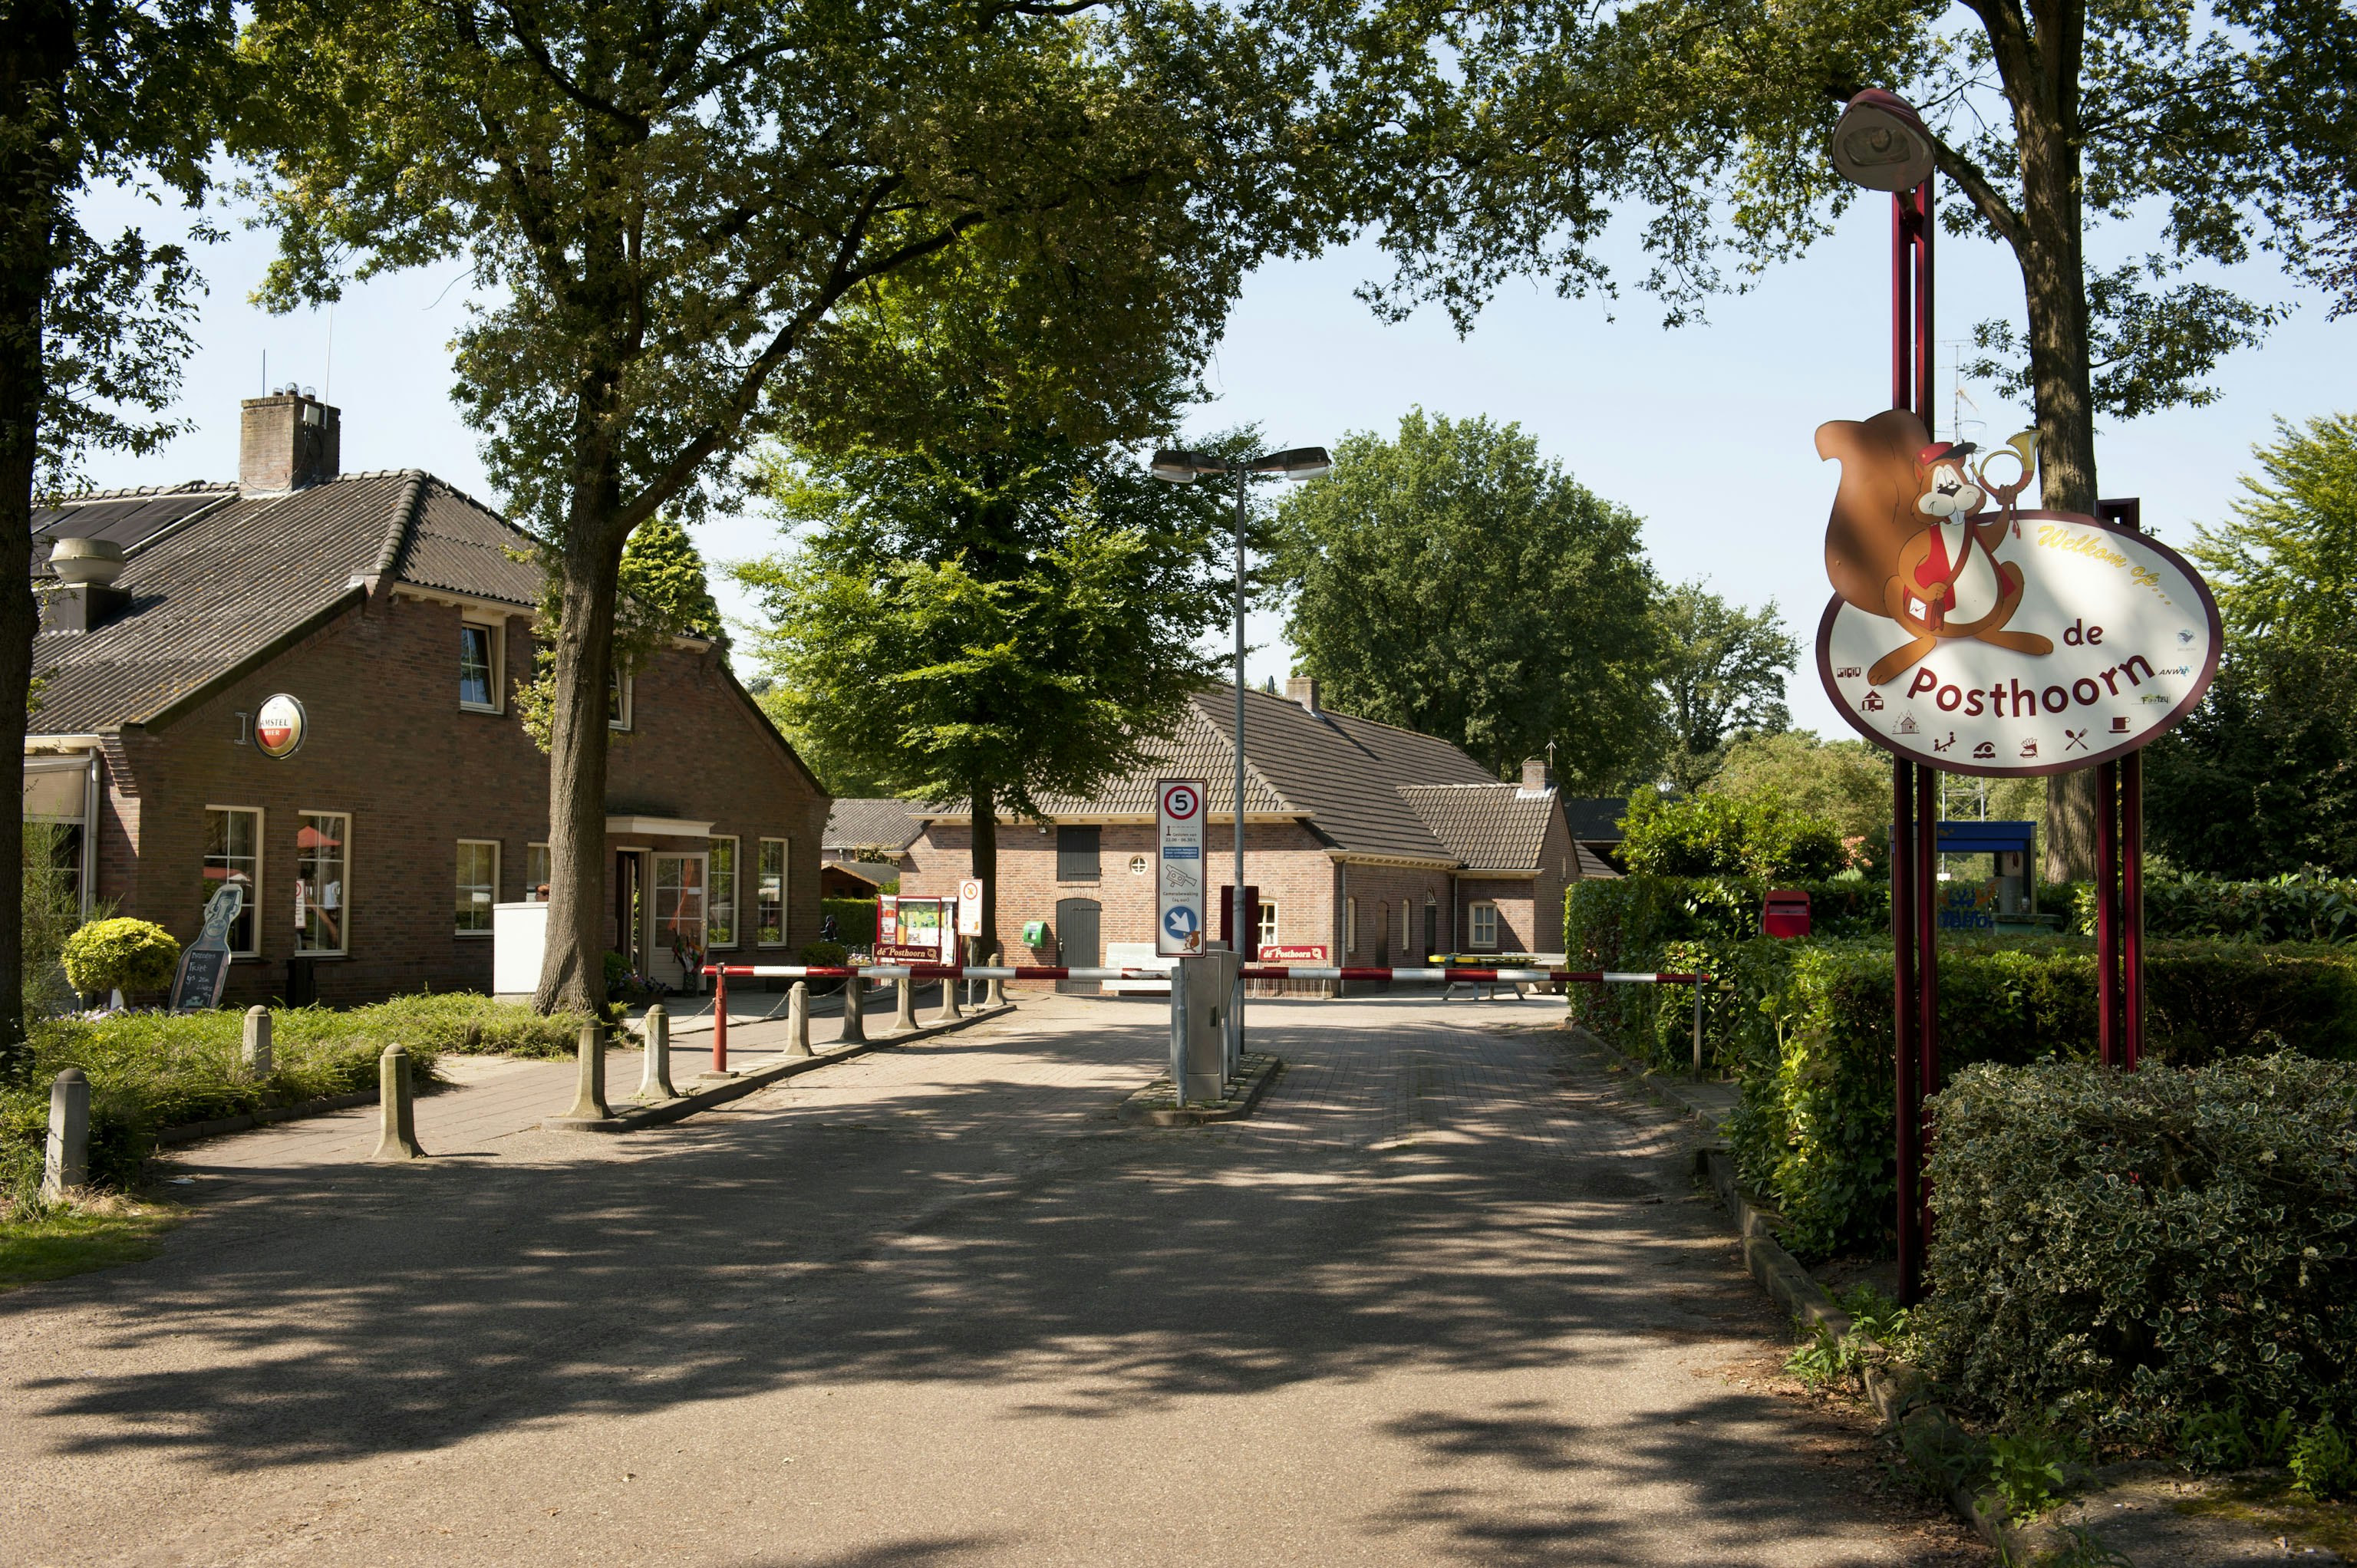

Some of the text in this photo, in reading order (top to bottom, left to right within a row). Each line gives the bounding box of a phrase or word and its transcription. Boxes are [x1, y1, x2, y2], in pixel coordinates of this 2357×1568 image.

[2038, 525, 2127, 568] Welkom
[2062, 618, 2105, 647] de
[1907, 654, 2156, 718] Posthoorn
[260, 719, 288, 727] AMSTEL
[1174, 794, 1188, 812] 5
[877, 947, 886, 956] de
[889, 947, 925, 957] Posthoorn
[1263, 950, 1273, 958] de
[1274, 949, 1311, 958] Posthoorn
